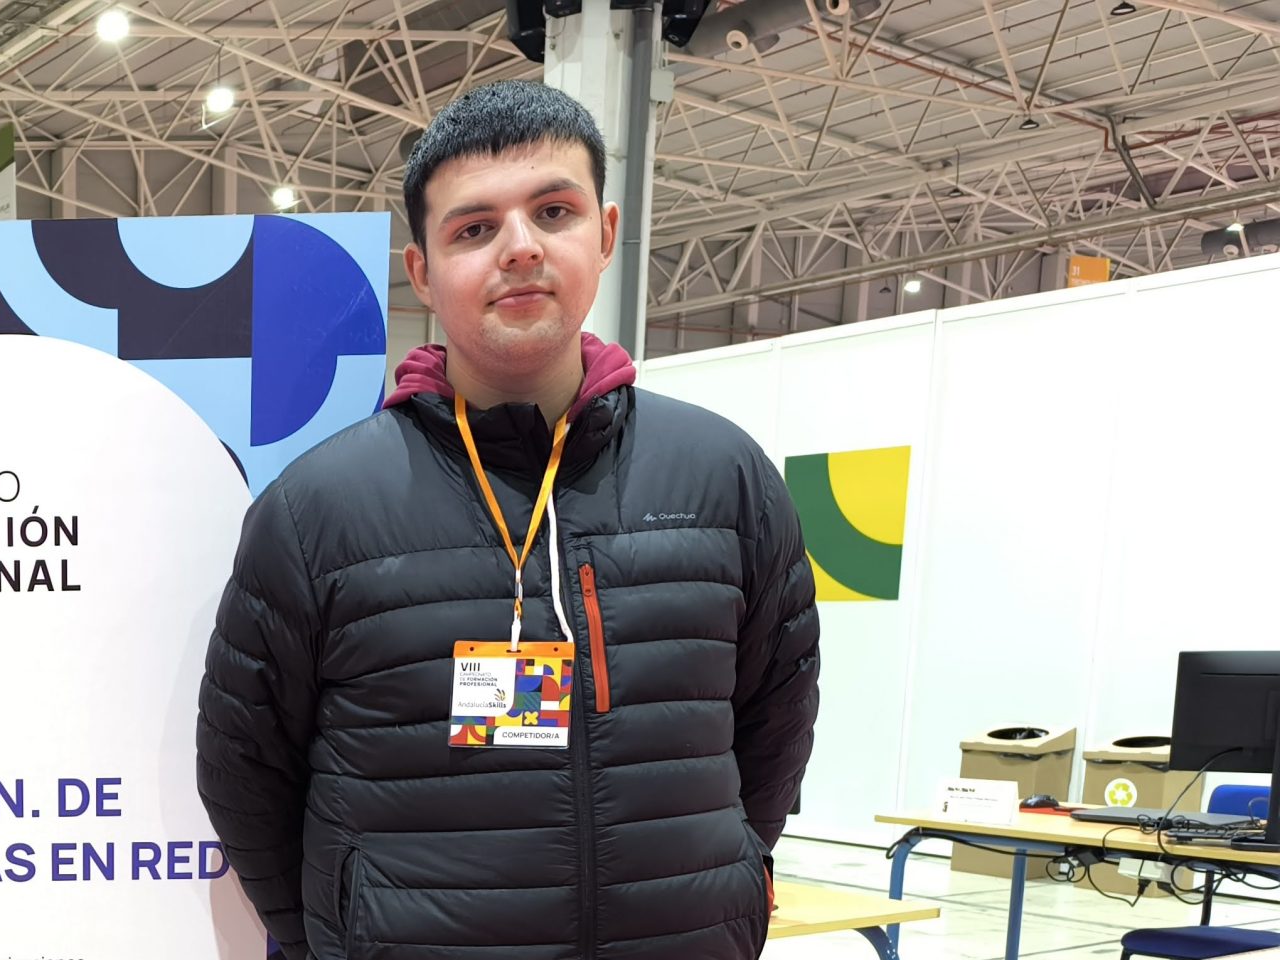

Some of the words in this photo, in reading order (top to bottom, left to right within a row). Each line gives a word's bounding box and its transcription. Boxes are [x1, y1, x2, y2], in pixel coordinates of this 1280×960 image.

[461, 662, 480, 671] VIII
[501, 731, 560, 739] COMPETIDOR/A
[58, 777, 122, 817] DE
[52, 842, 114, 881] EN
[132, 841, 229, 880] RED
